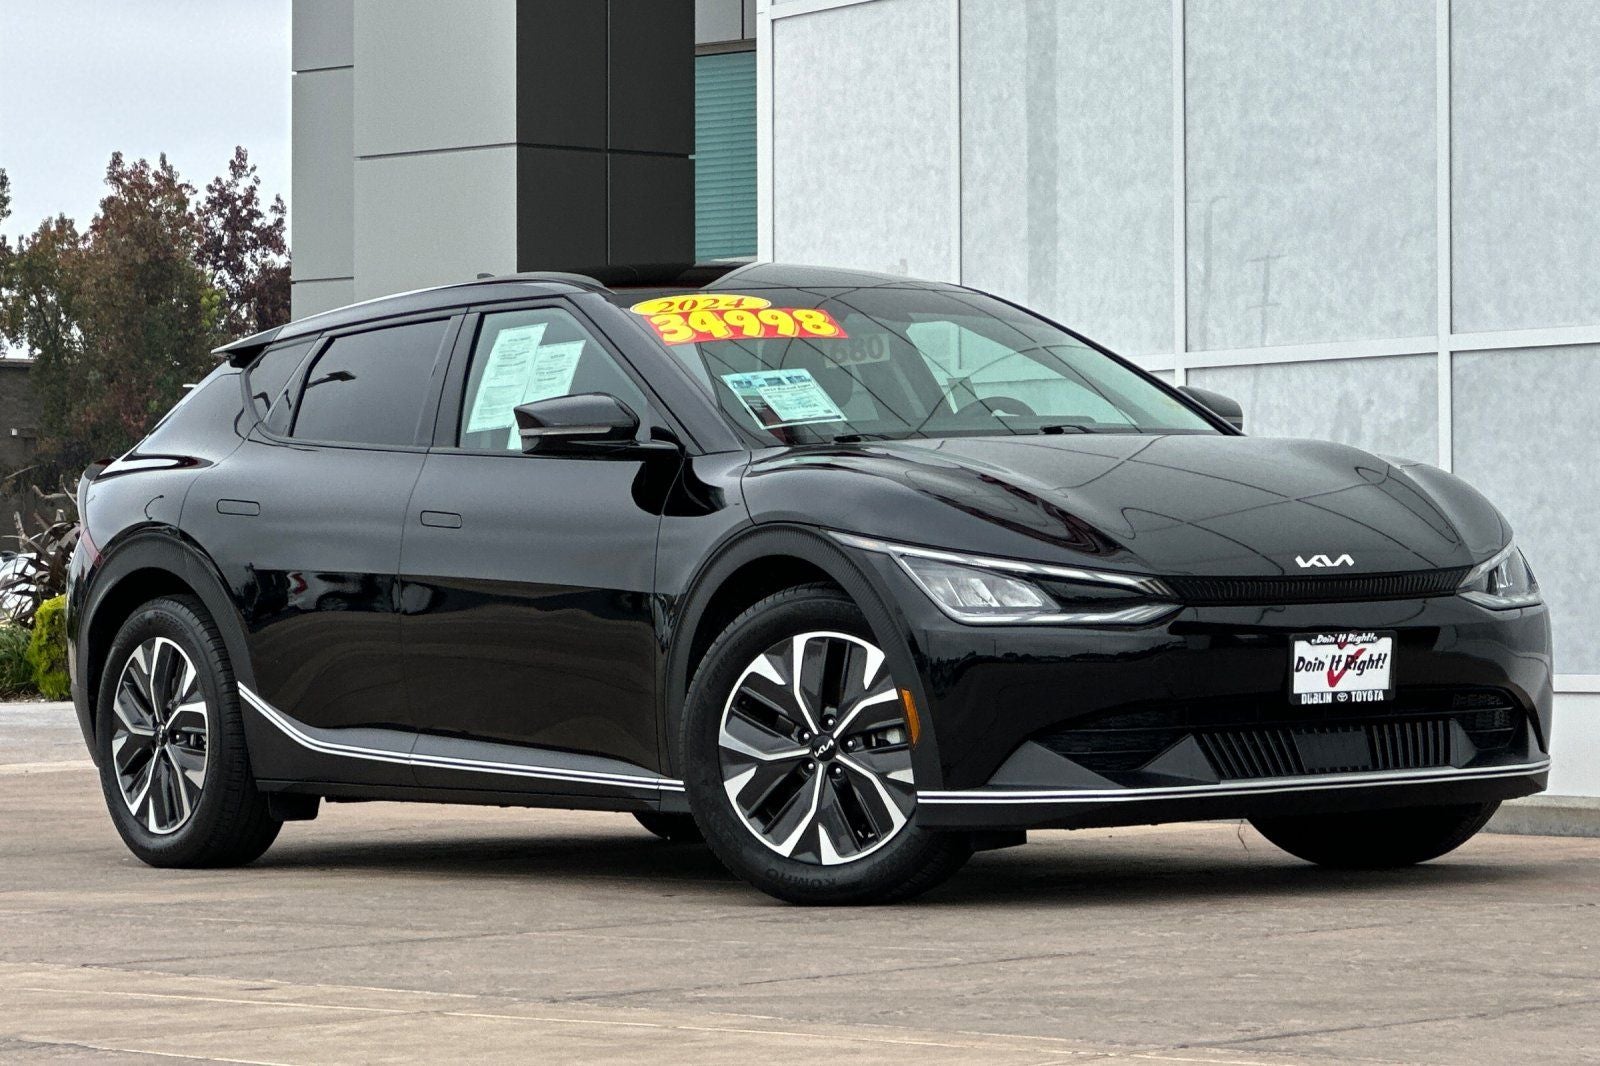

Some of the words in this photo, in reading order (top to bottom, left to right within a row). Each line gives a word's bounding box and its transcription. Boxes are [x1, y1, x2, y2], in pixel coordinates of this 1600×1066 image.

[657, 297, 745, 314] 2024
[650, 309, 840, 343] 34998
[1295, 554, 1355, 568] KIA
[1337, 633, 1347, 643] It
[1294, 654, 1329, 673] Doin'
[1329, 654, 1343, 672] It
[1343, 652, 1388, 676] Right!
[1301, 692, 1333, 705] DUBLIN
[1350, 689, 1384, 703] TOYOTA
[814, 738, 835, 758] KIA
